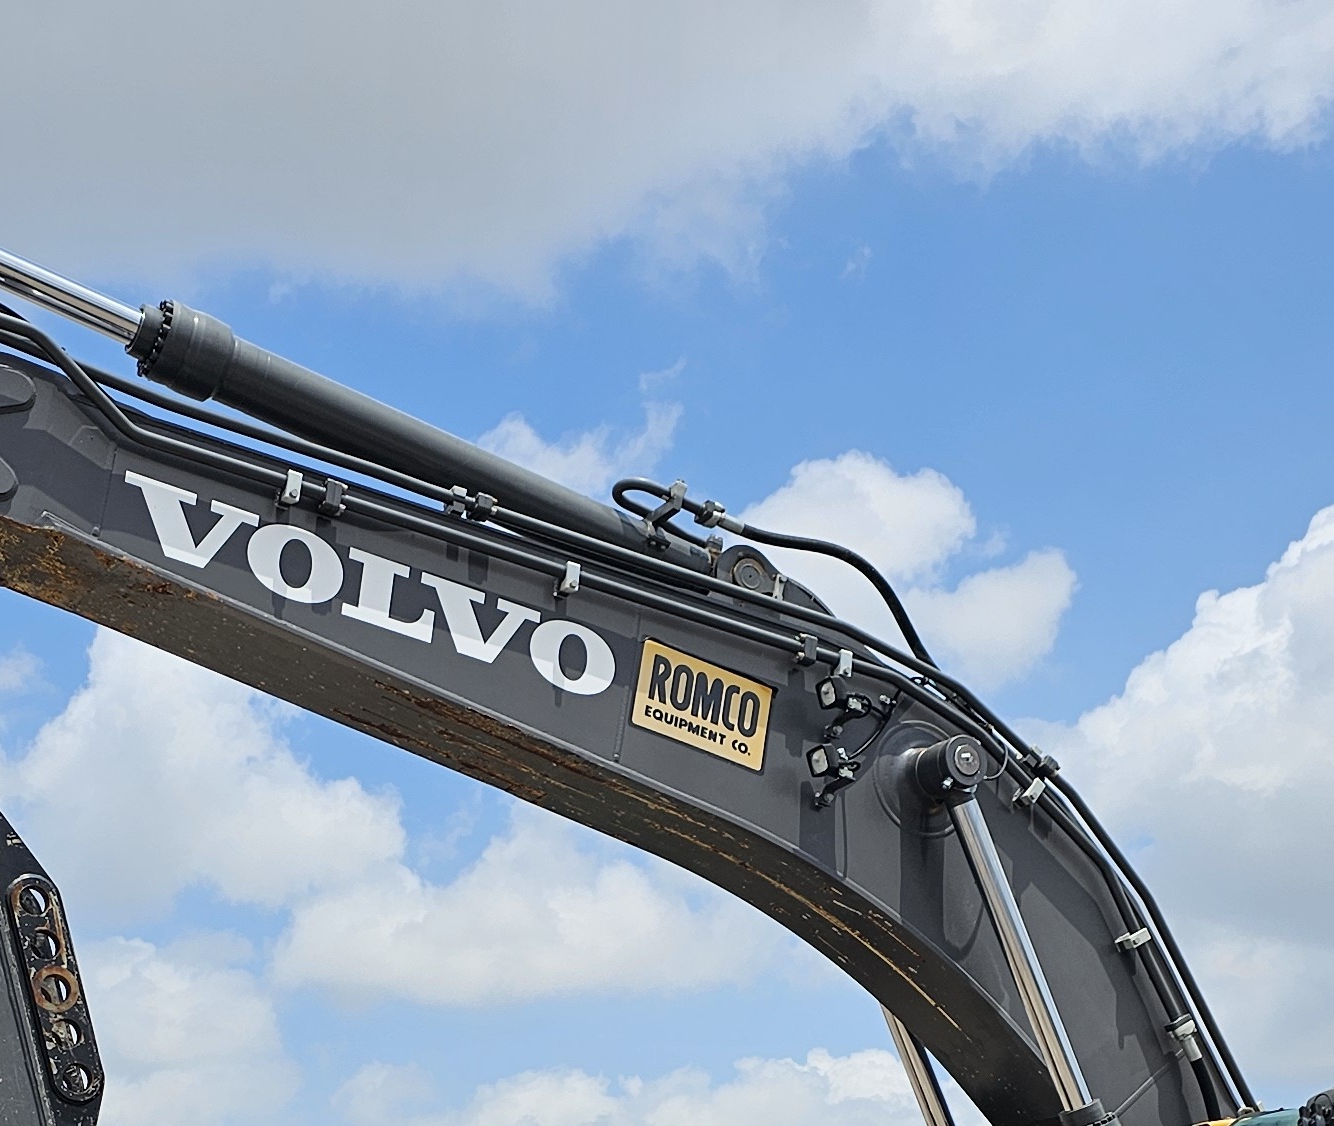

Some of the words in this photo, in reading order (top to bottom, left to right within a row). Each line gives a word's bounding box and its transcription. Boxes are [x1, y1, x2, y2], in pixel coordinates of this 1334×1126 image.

[124, 470, 616, 696] VOLVO
[644, 704, 727, 746] EQUIPMENT
[731, 739, 751, 757] CO.
[647, 653, 761, 738] ROMCO
